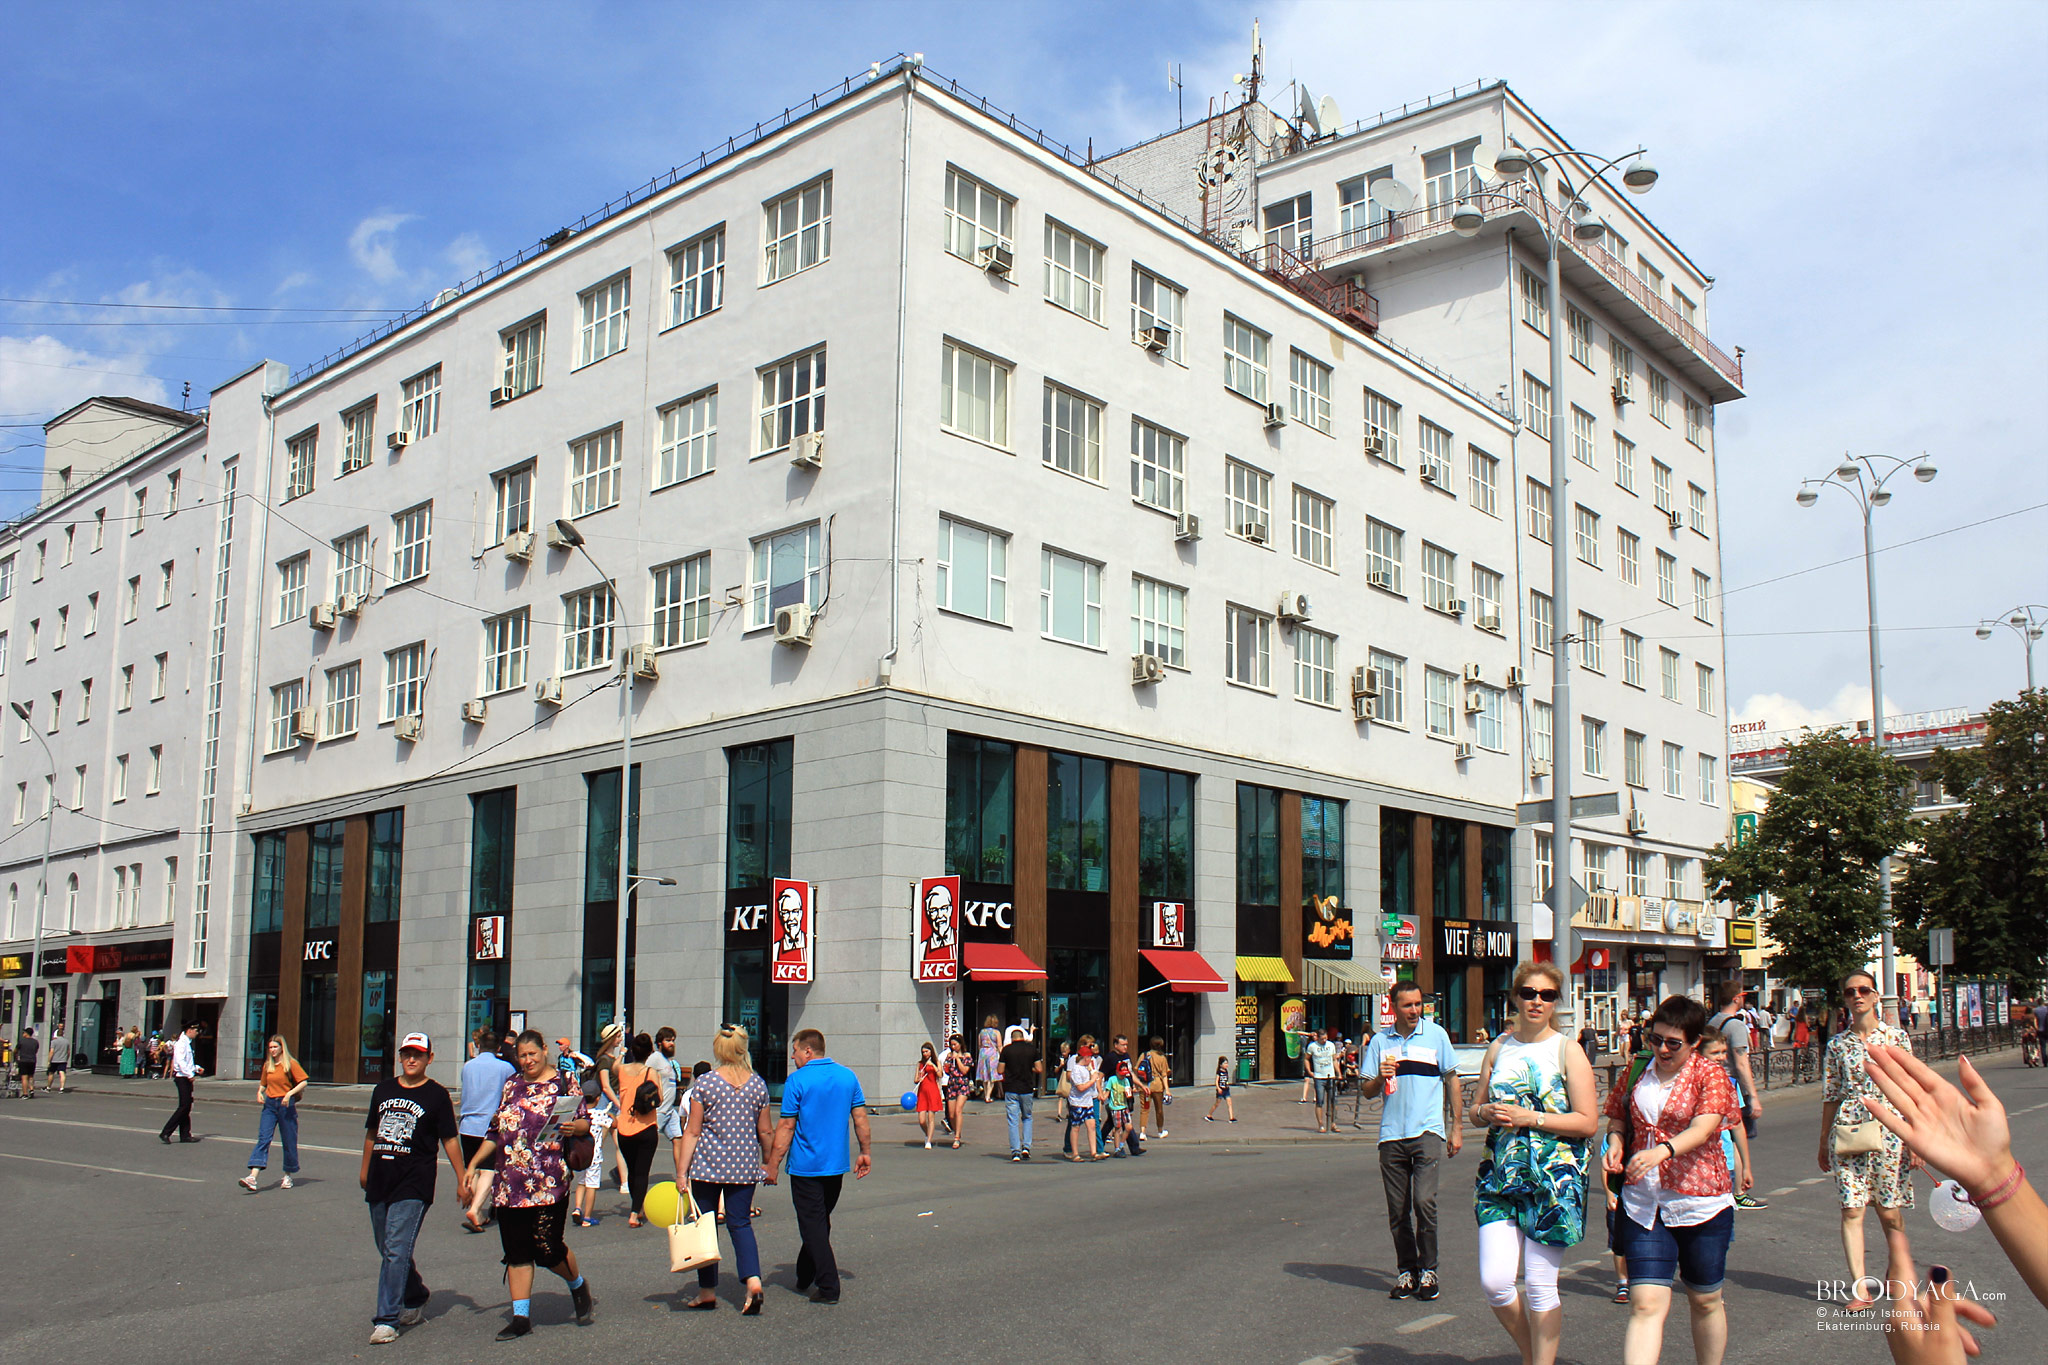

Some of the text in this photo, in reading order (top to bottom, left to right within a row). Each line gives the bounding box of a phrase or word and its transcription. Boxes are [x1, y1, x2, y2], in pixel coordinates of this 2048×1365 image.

[731, 905, 767, 931] KF
[965, 901, 1012, 929] KFC
[304, 940, 333, 960] KFC
[1384, 943, 1422, 960] АПТЕКА
[1445, 928, 1511, 957] VIET MON
[776, 964, 806, 979] KFC
[922, 963, 955, 977] KFC
[471, 988, 487, 998] KFC
[379, 1098, 425, 1118] EXPEDITION
[393, 1145, 411, 1153] PEAKS
